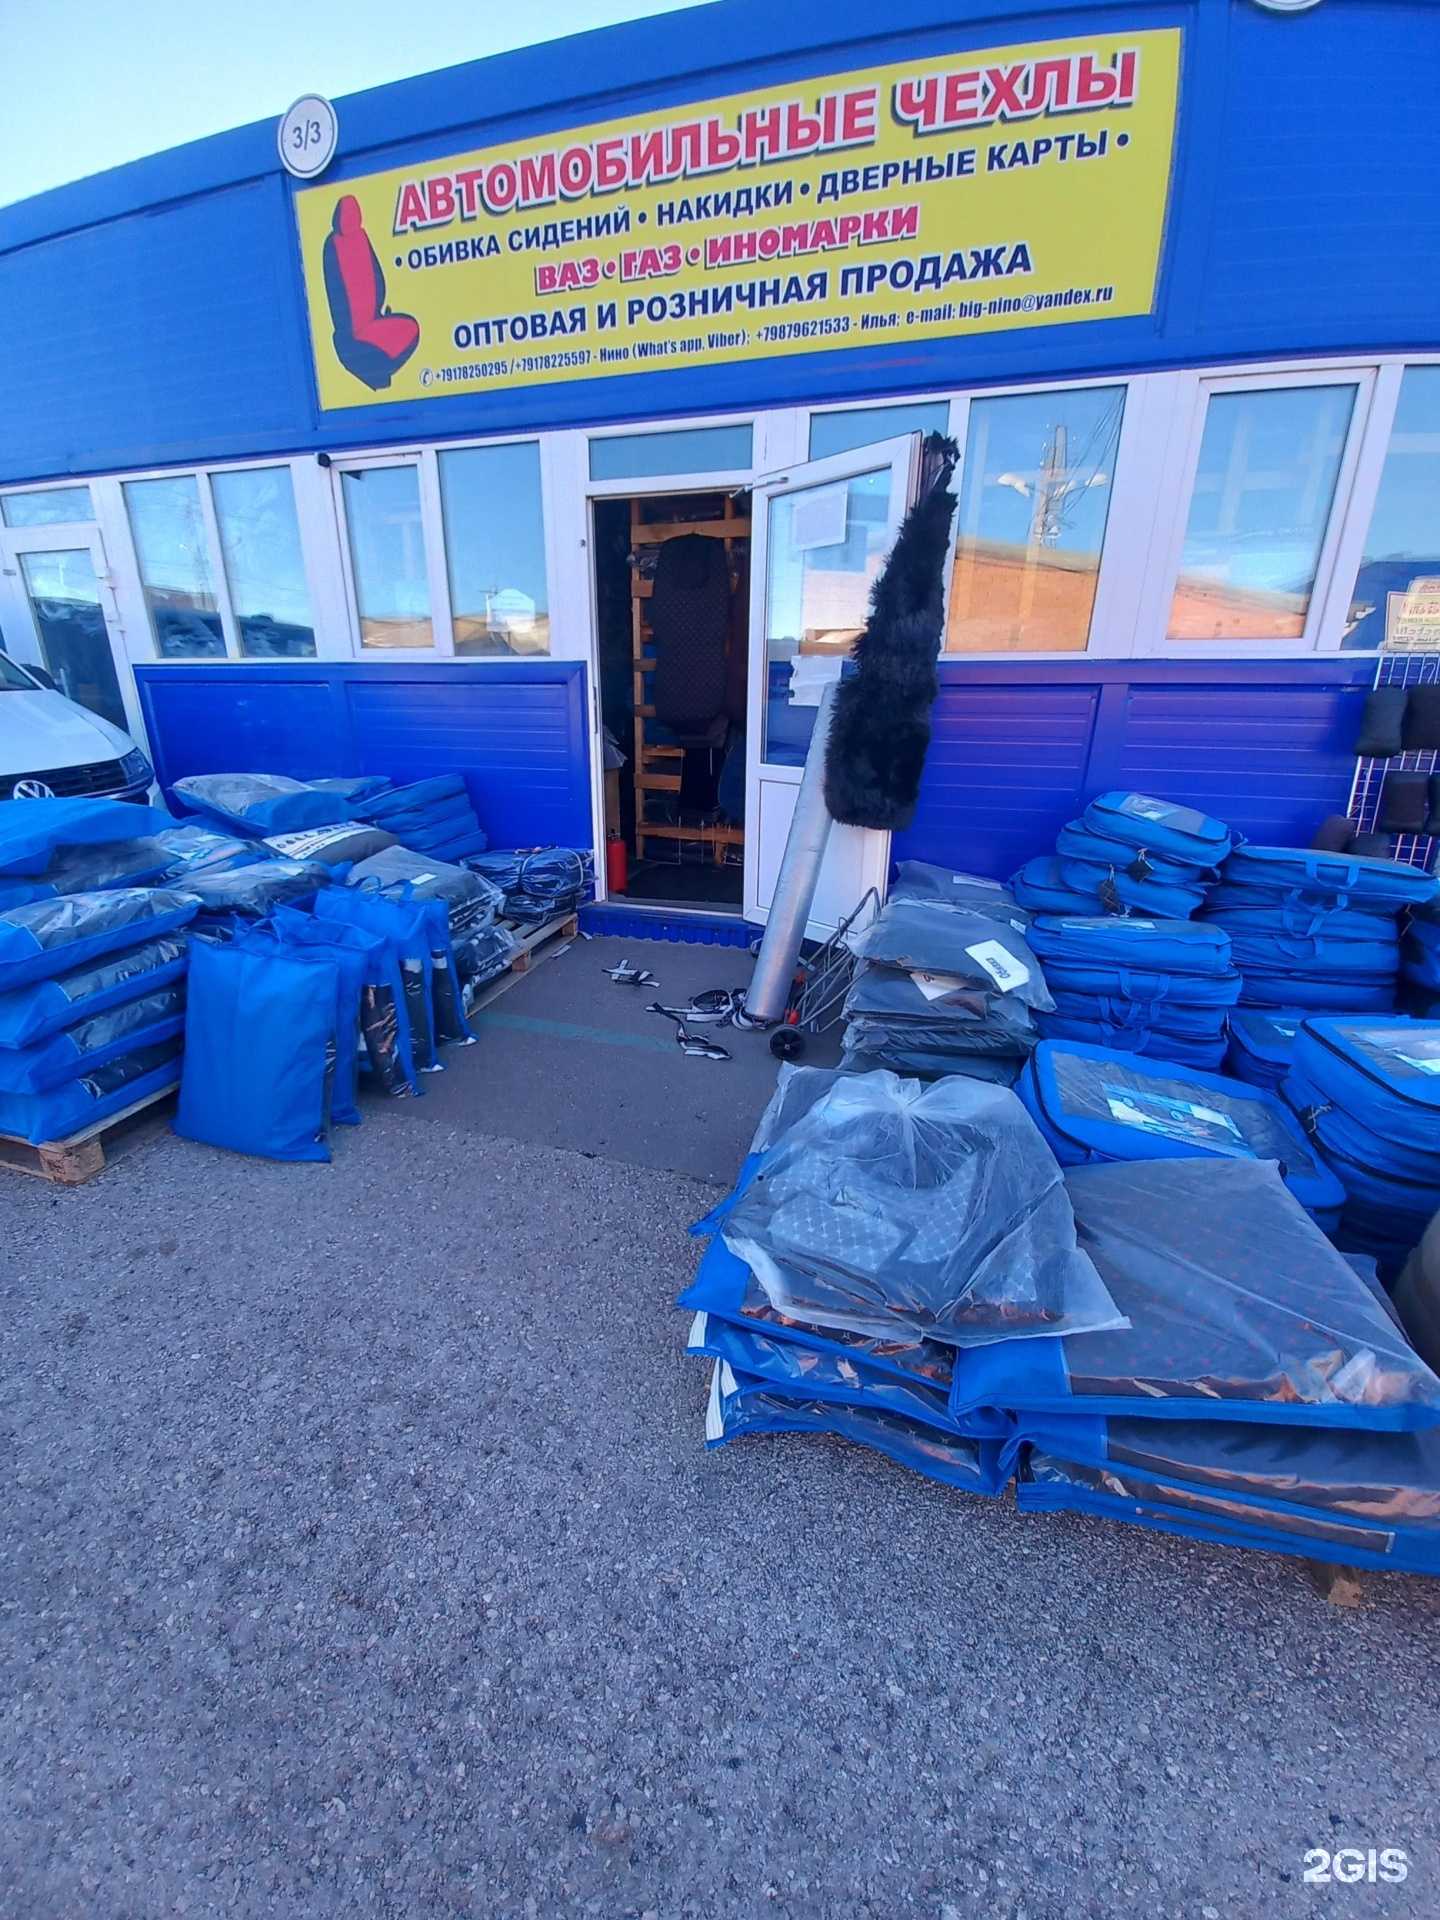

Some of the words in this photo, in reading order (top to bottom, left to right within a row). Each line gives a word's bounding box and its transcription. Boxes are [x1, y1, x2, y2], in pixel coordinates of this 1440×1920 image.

[292, 119, 321, 151] 3/3
[396, 88, 877, 229] АВТОМОБИЛЬНЫЕ
[896, 50, 1137, 129] ЧЕХЛЫ
[407, 236, 500, 269] ОБИВКА
[508, 210, 631, 252] СИДЕНИЙ
[656, 180, 793, 226] НАКИДКИ
[817, 149, 975, 204] ДВЕРНЫЕ
[987, 131, 1107, 173] КАРТЫ
[453, 306, 586, 348] ОПТОВАЯ
[597, 303, 617, 330] И
[628, 273, 828, 326] РОЗНИЧНАЯ
[840, 243, 1032, 296] ПРОДАЖА
[536, 257, 600, 293] ВАЗ
[621, 248, 682, 278] ГАЗ
[706, 205, 919, 266] ИНОМАРКИ
[959, 286, 1113, 319] big-nino@yandex.ru
